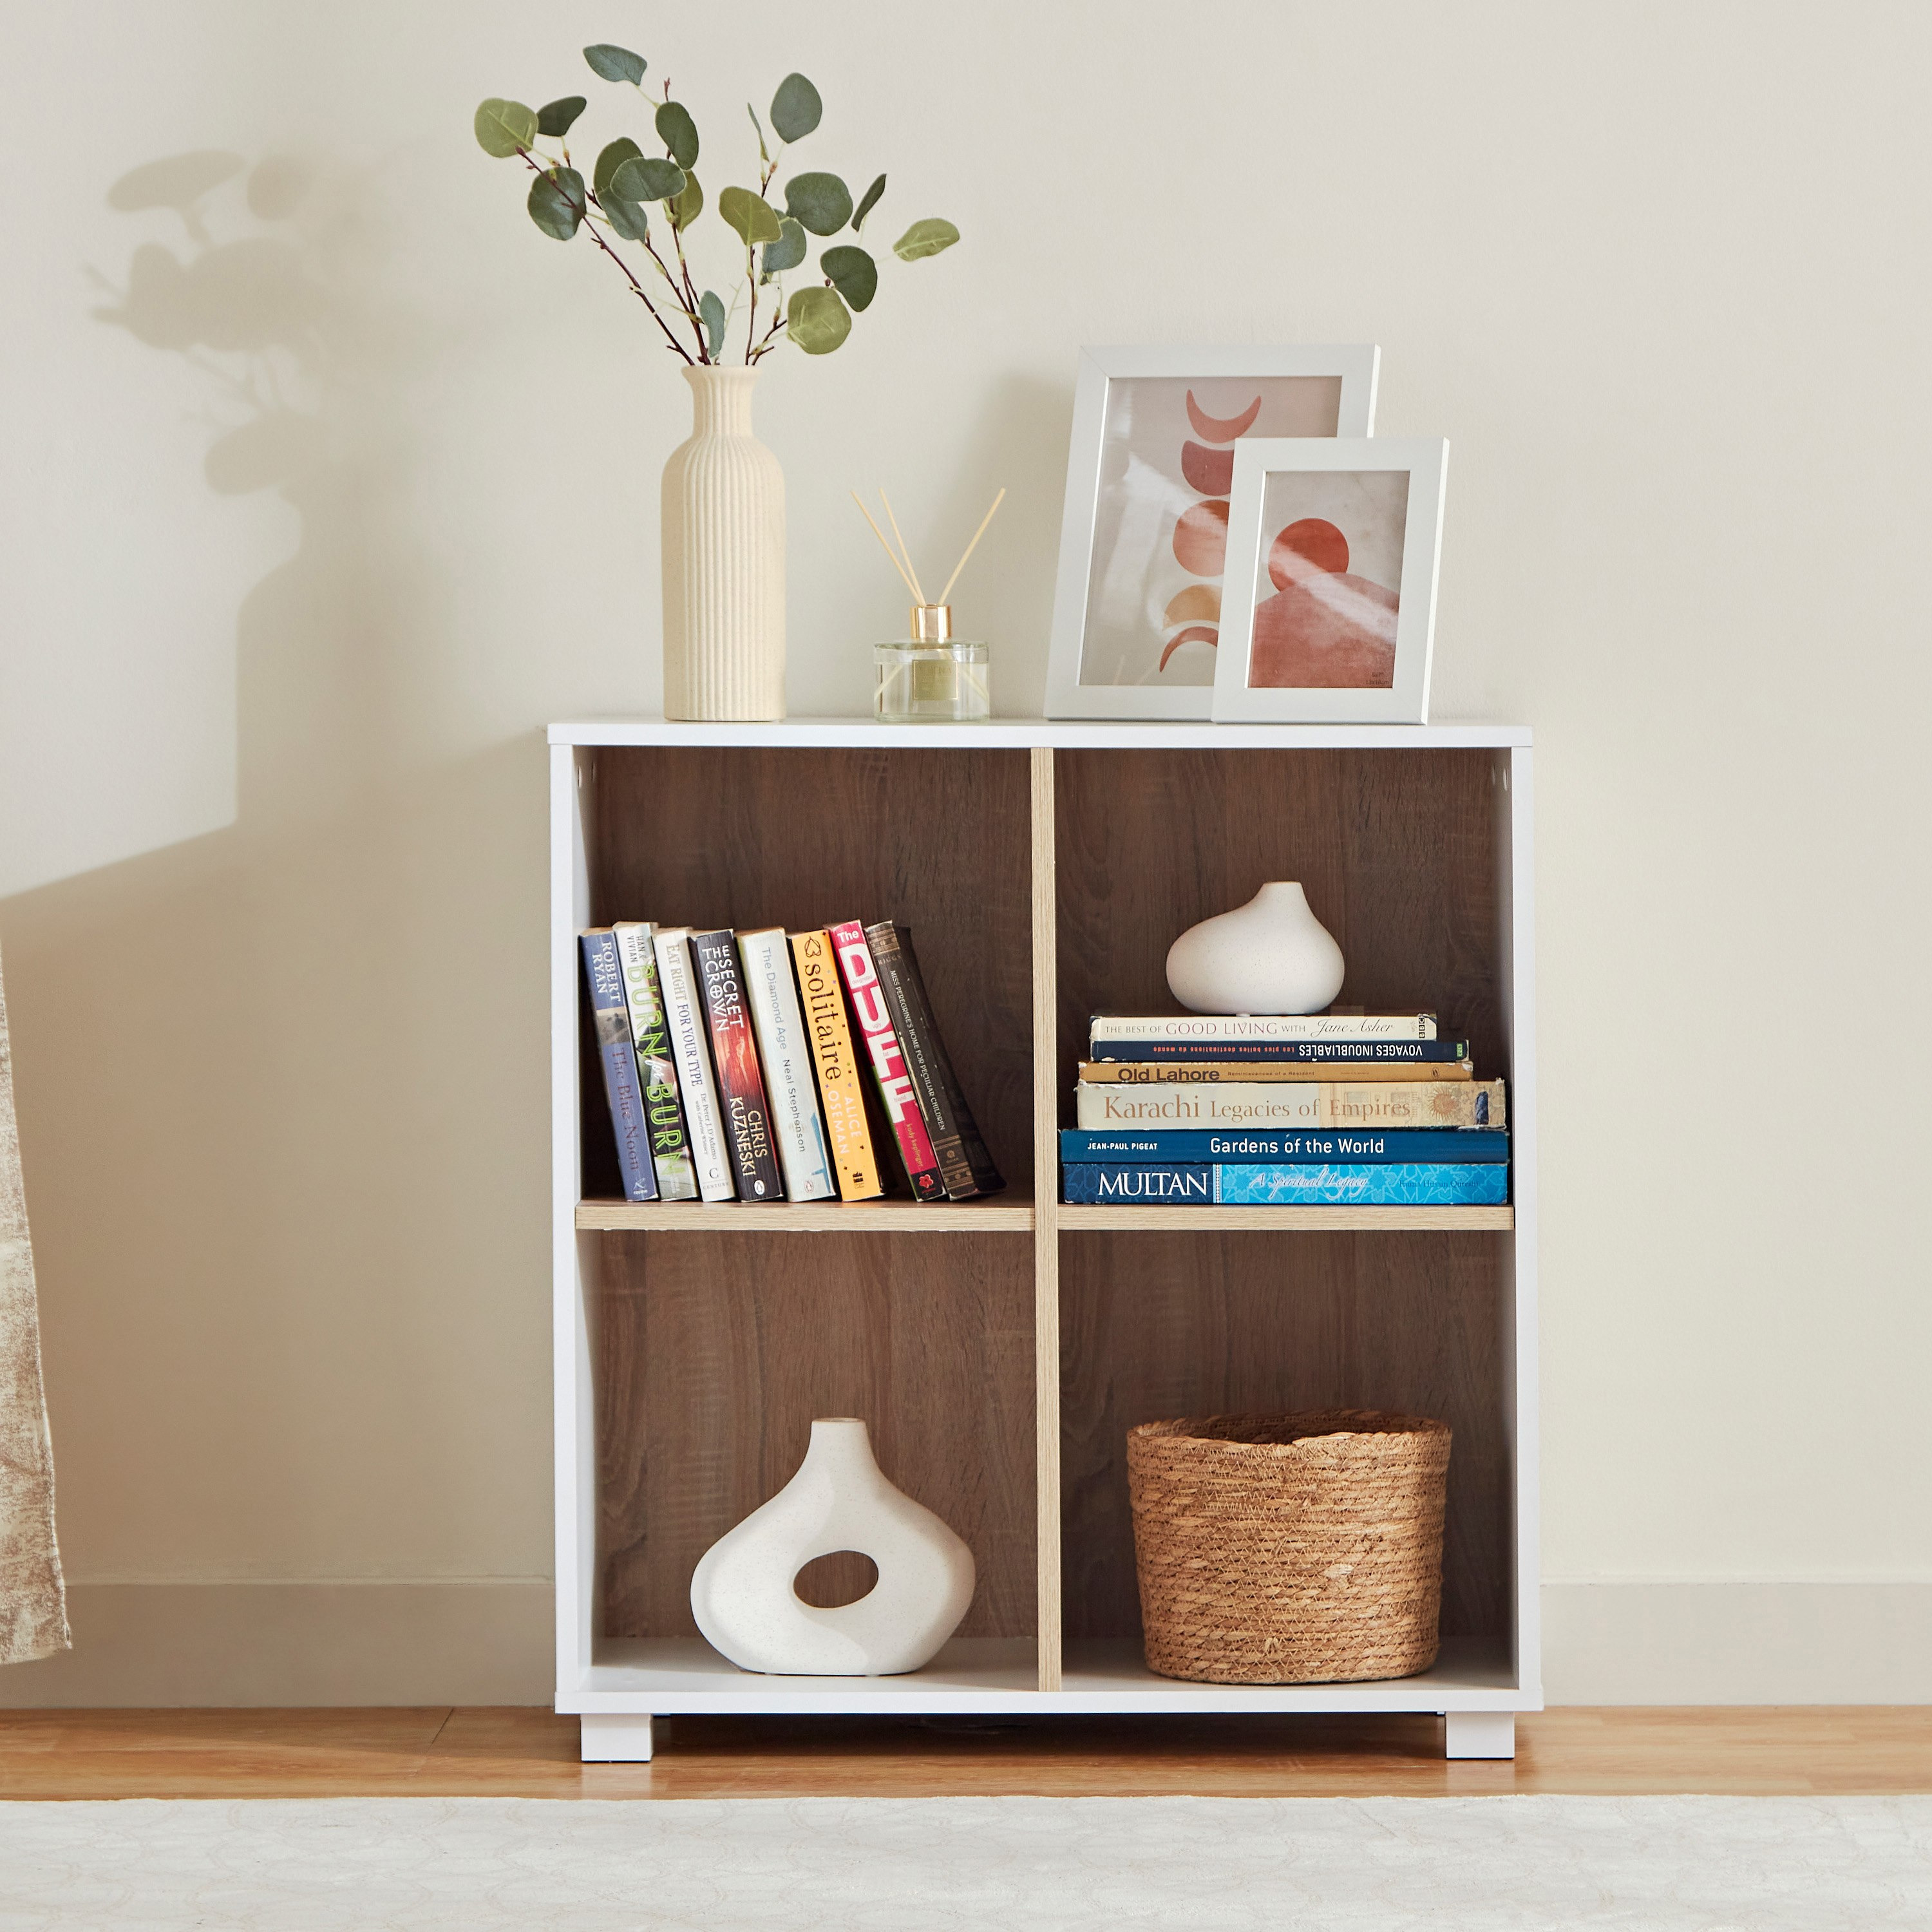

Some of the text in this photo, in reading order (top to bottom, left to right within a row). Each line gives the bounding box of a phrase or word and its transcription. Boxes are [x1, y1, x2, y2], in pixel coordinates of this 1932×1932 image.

[627, 936, 638, 962] VIVIAN
[636, 935, 645, 952] HAN
[701, 945, 730, 960] THE
[837, 930, 859, 943] The
[592, 954, 607, 993] RYAN
[601, 942, 621, 1001] ROBERT
[878, 954, 902, 965] RIGGS
[666, 944, 703, 1086] EAT RIGHT FOR YOUR TYPE
[705, 960, 730, 1031] CROWN
[719, 958, 744, 1028] SECRET
[762, 947, 787, 1050] The Diamond Age
[805, 963, 841, 1080] solitaire
[838, 943, 916, 1123] DUFF
[1166, 1023, 1217, 1034] GOOD
[1224, 1023, 1278, 1034] LIVING
[1311, 1018, 1349, 1037] Jane
[1350, 1018, 1393, 1032] Asher
[627, 963, 685, 1175] BURN for BURN
[890, 970, 900, 985] MISS
[909, 1028, 920, 1050] HOME
[915, 1050, 923, 1065] FOR
[920, 1065, 934, 1097] PECULIAR
[931, 1097, 945, 1130] CHILDREN
[1299, 1045, 1423, 1056] VOYAGES INOUBLIABLES
[1118, 1068, 1150, 1081] Old
[1157, 1068, 1220, 1081] Lahore
[612, 1048, 639, 1170] The Blue Noon
[783, 1059, 805, 1153] Neal Stephenson
[828, 1090, 850, 1154] OSEMAN
[844, 1097, 862, 1137] ALICE
[1104, 1094, 1410, 1122] Karachi Legacies of Empires
[707, 1129, 717, 1159] D'Adamo
[730, 1096, 755, 1176] KUZNESKI
[747, 1110, 768, 1158] CHRIS
[906, 1123, 923, 1167] kody keplinger
[1210, 1137, 1278, 1153] Gardens
[1284, 1138, 1301, 1153] of
[1305, 1139, 1332, 1153] the
[1338, 1138, 1384, 1153] World
[1098, 1172, 1208, 1196] MULTAN
[1250, 1173, 1265, 1188] A
[1324, 1171, 1368, 1200] Legacy
